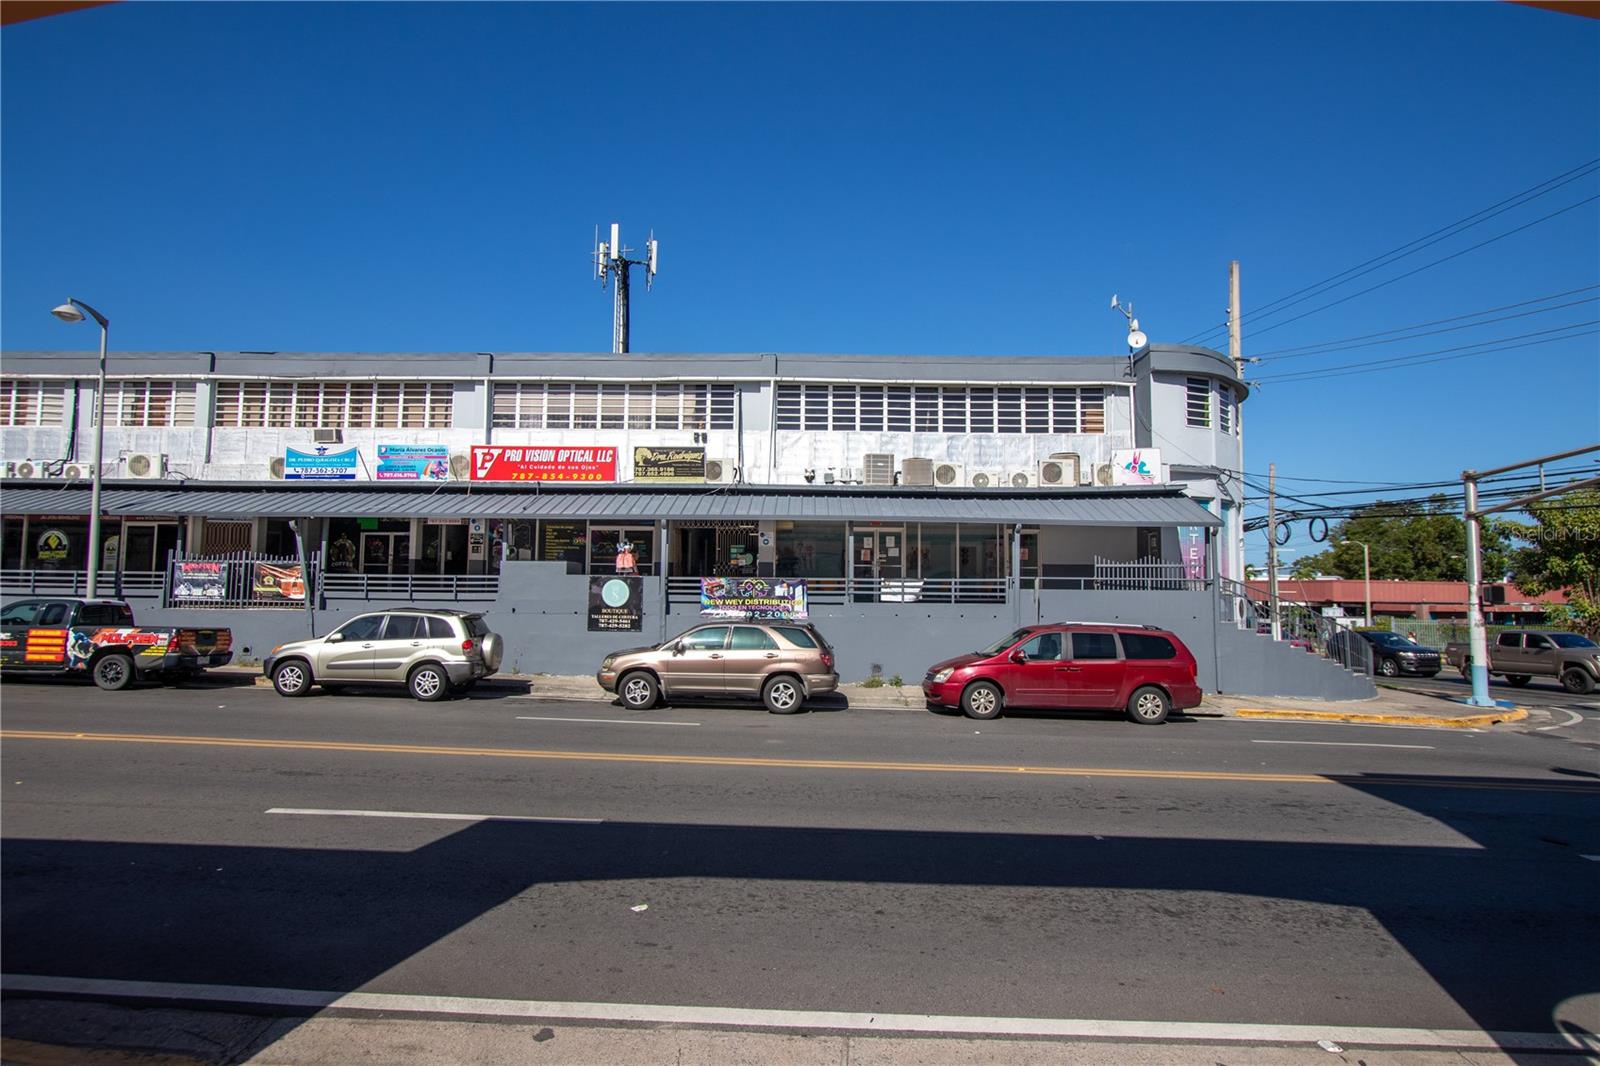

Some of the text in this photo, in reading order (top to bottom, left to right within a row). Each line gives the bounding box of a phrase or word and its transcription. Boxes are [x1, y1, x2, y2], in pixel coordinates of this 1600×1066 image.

[504, 449, 614, 462] PRO VISION OPTICAL LLC
[512, 472, 602, 480] 787-854-9300
